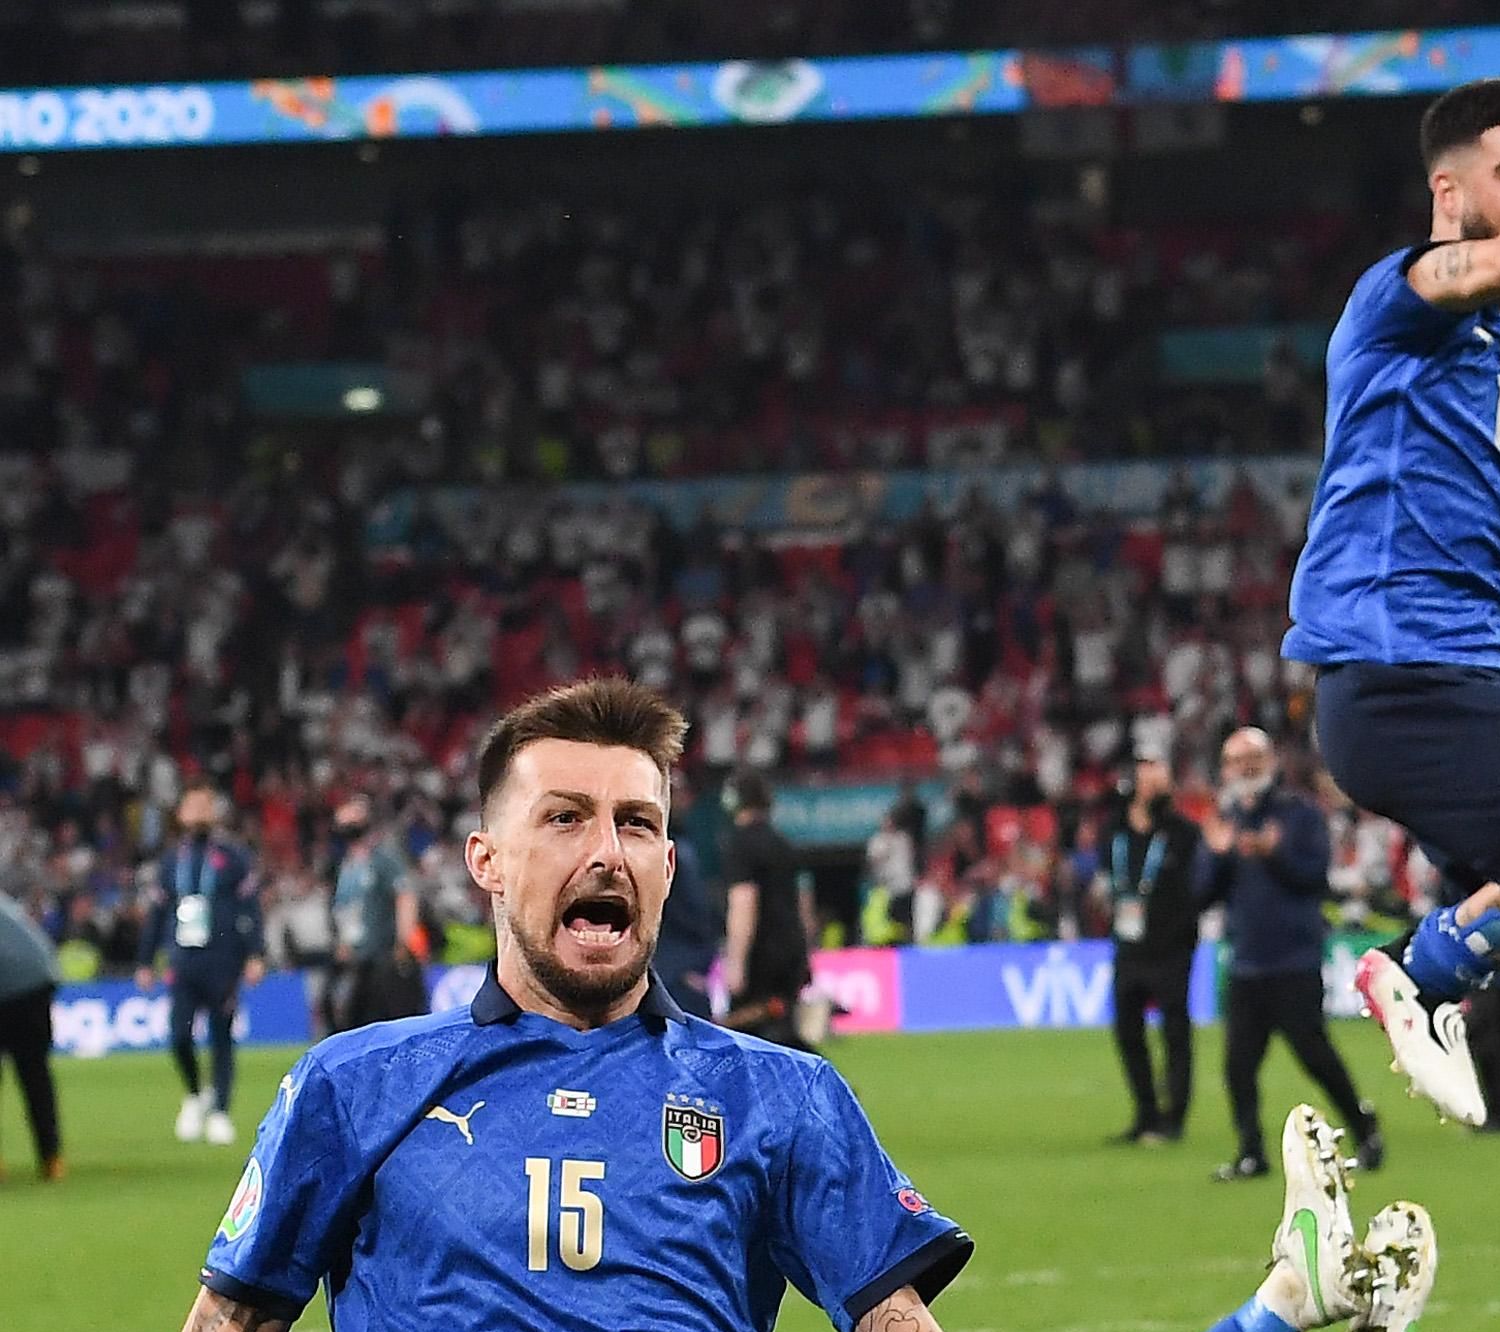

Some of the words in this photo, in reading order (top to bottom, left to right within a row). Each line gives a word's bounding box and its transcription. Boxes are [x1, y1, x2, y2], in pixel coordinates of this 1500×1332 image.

[73, 85, 212, 143] 2020
[667, 1109, 717, 1132] ITALIA
[524, 1157, 606, 1272] 15
